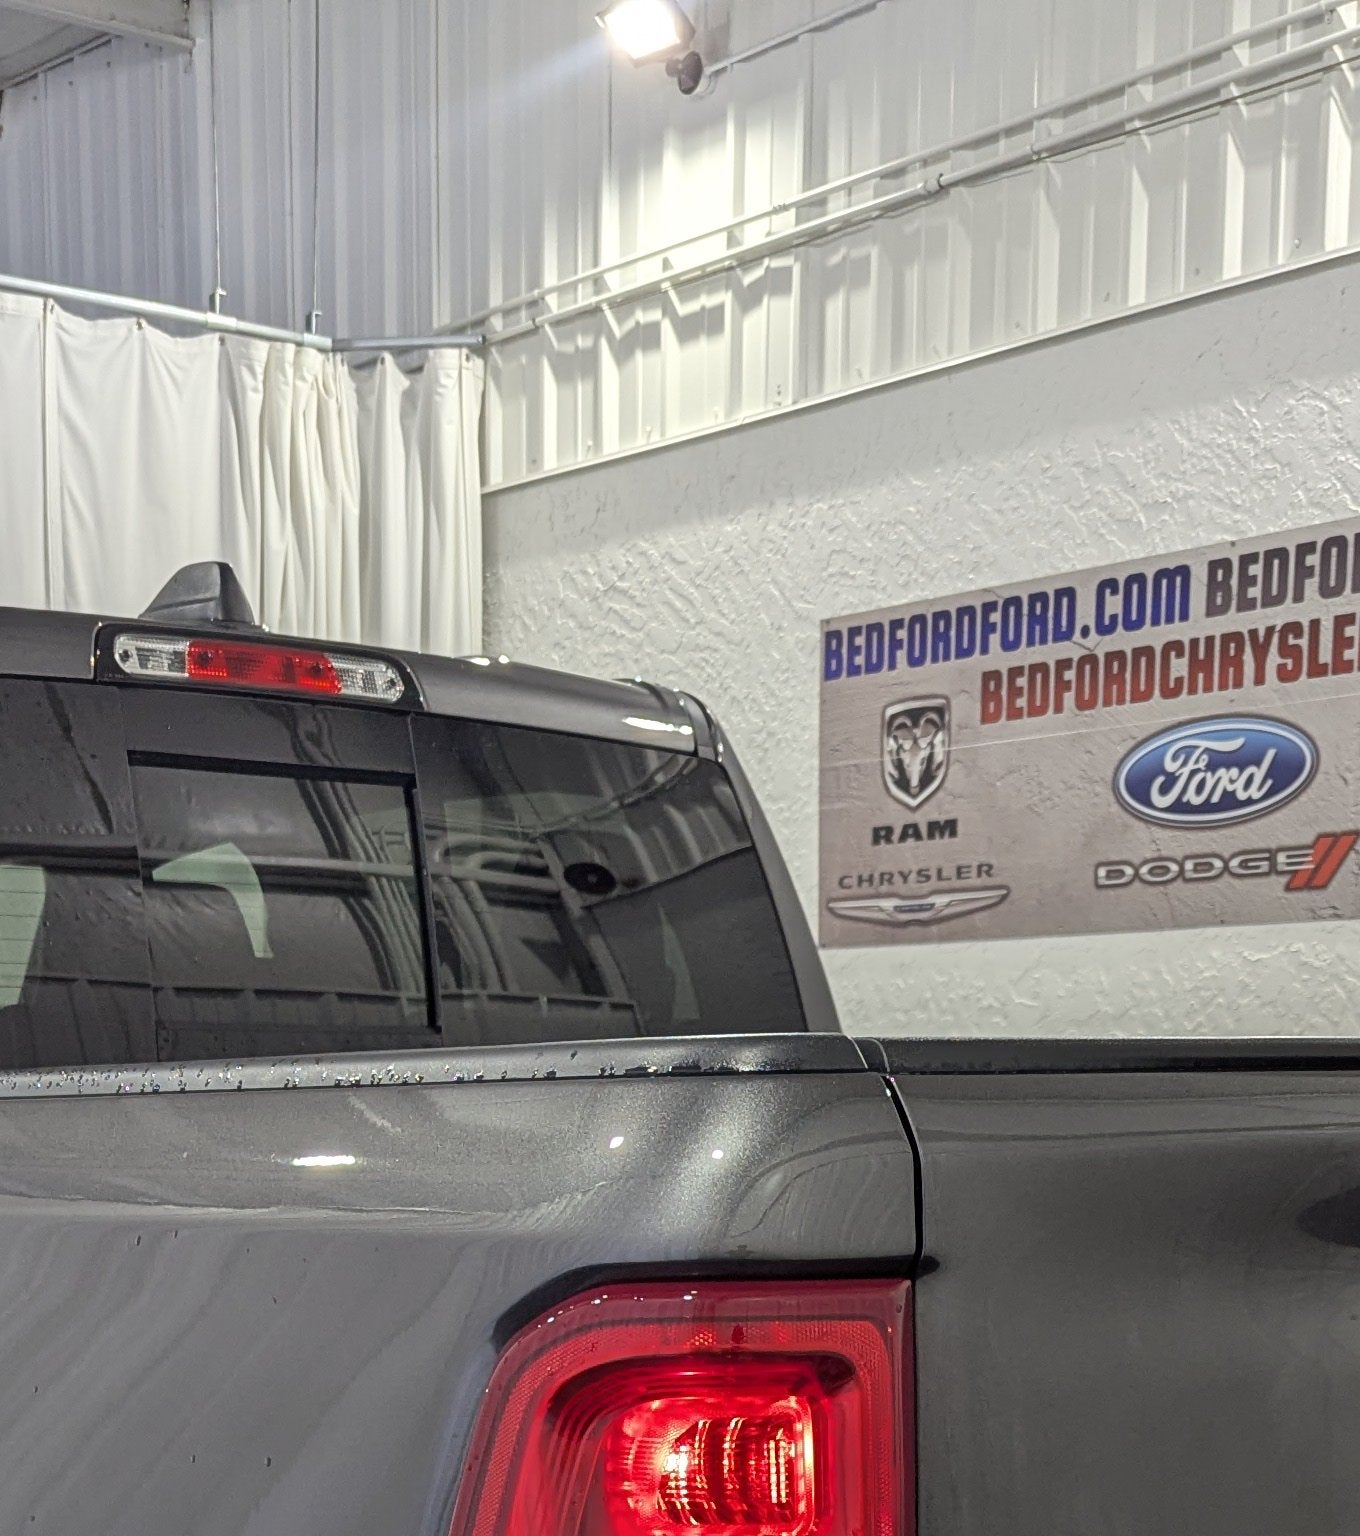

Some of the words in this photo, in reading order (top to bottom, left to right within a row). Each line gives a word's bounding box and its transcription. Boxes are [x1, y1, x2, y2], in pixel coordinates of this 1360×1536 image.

[823, 564, 1191, 681] BEDFORDFORD.COM
[1150, 736, 1277, 809] Ford
[871, 817, 958, 846] RAM
[838, 863, 994, 890] CHRYSLER
[1095, 846, 1316, 888] DODGE
